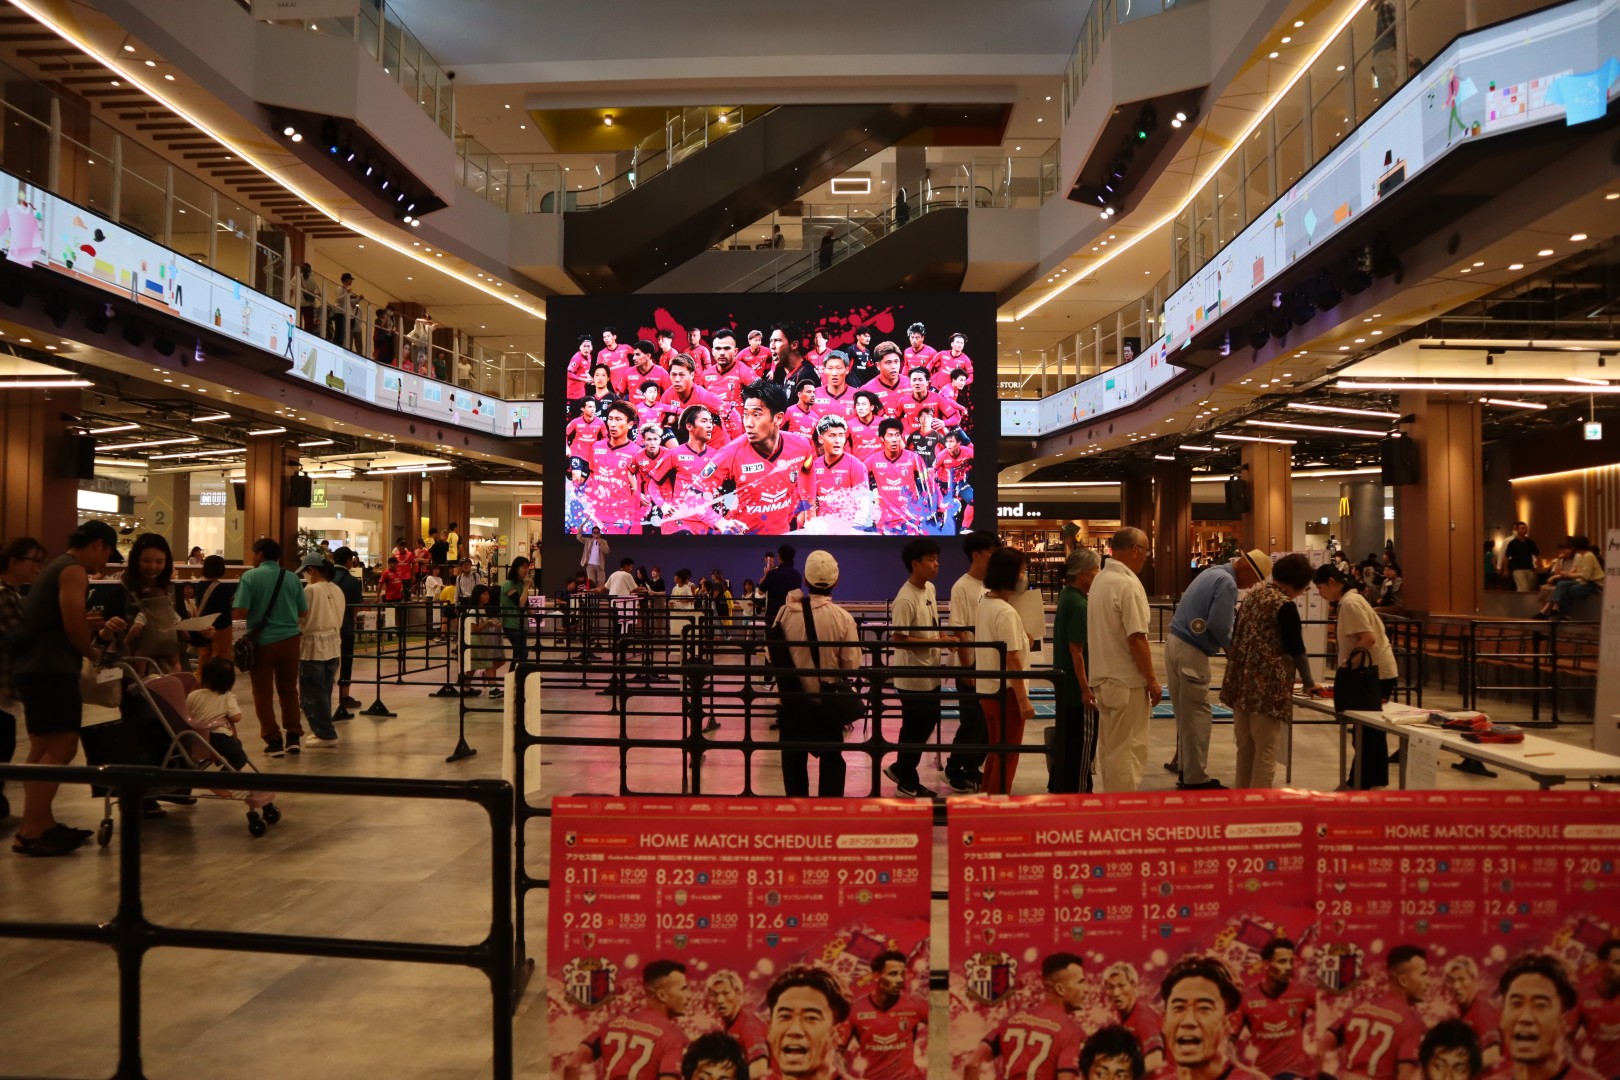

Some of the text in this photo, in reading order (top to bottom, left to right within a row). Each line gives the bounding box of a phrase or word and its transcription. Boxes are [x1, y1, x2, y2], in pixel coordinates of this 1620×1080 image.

[155, 511, 165, 525] 2
[232, 518, 238, 531] 1
[1036, 825, 1221, 844] HOME MATCH SCHEDULE
[1385, 824, 1430, 838] HOME
[1435, 824, 1485, 838] MATCH
[1489, 824, 1560, 839] SCHEDULE
[640, 834, 833, 849] HOME MATCH SCHEDULE
[1053, 864, 1090, 880] 8.23
[1107, 863, 1133, 873] 19:00
[1141, 861, 1176, 877] 8.31
[1193, 859, 1220, 869] 19:00
[1227, 857, 1264, 874] 9.20
[1279, 856, 1304, 866] 18:30
[1317, 858, 1347, 873] 8.11
[1400, 858, 1436, 873] 8.23
[1483, 858, 1516, 873] 8.31
[1564, 858, 1601, 873] 9.20
[565, 867, 597, 884] 8.11
[620, 868, 648, 878] 19:00
[656, 869, 694, 885] 8.23
[711, 869, 739, 879] 19:00
[747, 869, 783, 885] 8.31
[802, 869, 830, 879] 19:00
[837, 869, 876, 885] 9.20
[892, 868, 919, 878] 18:30
[963, 866, 996, 882] 8.11
[1018, 865, 1044, 875] 19:00
[1054, 906, 1091, 922] 10.25
[1107, 905, 1133, 915] 15:00
[1142, 904, 1177, 919] 12.6
[1194, 902, 1220, 912] 14:00
[1316, 900, 1352, 916] 9.28
[1400, 900, 1436, 915] 10.25
[1484, 900, 1517, 915] 12.6
[563, 912, 603, 929] 9.28
[619, 913, 647, 923] 18:30
[656, 913, 695, 929] 10.25
[711, 913, 738, 923] 15:00
[749, 913, 784, 929] 12.6
[802, 913, 829, 922] 14:00
[964, 909, 1002, 925] 9.28
[1018, 908, 1045, 918] 18:30
[604, 1031, 655, 1080] 77
[1004, 1028, 1053, 1080] 77
[1347, 1018, 1396, 1078] 77
